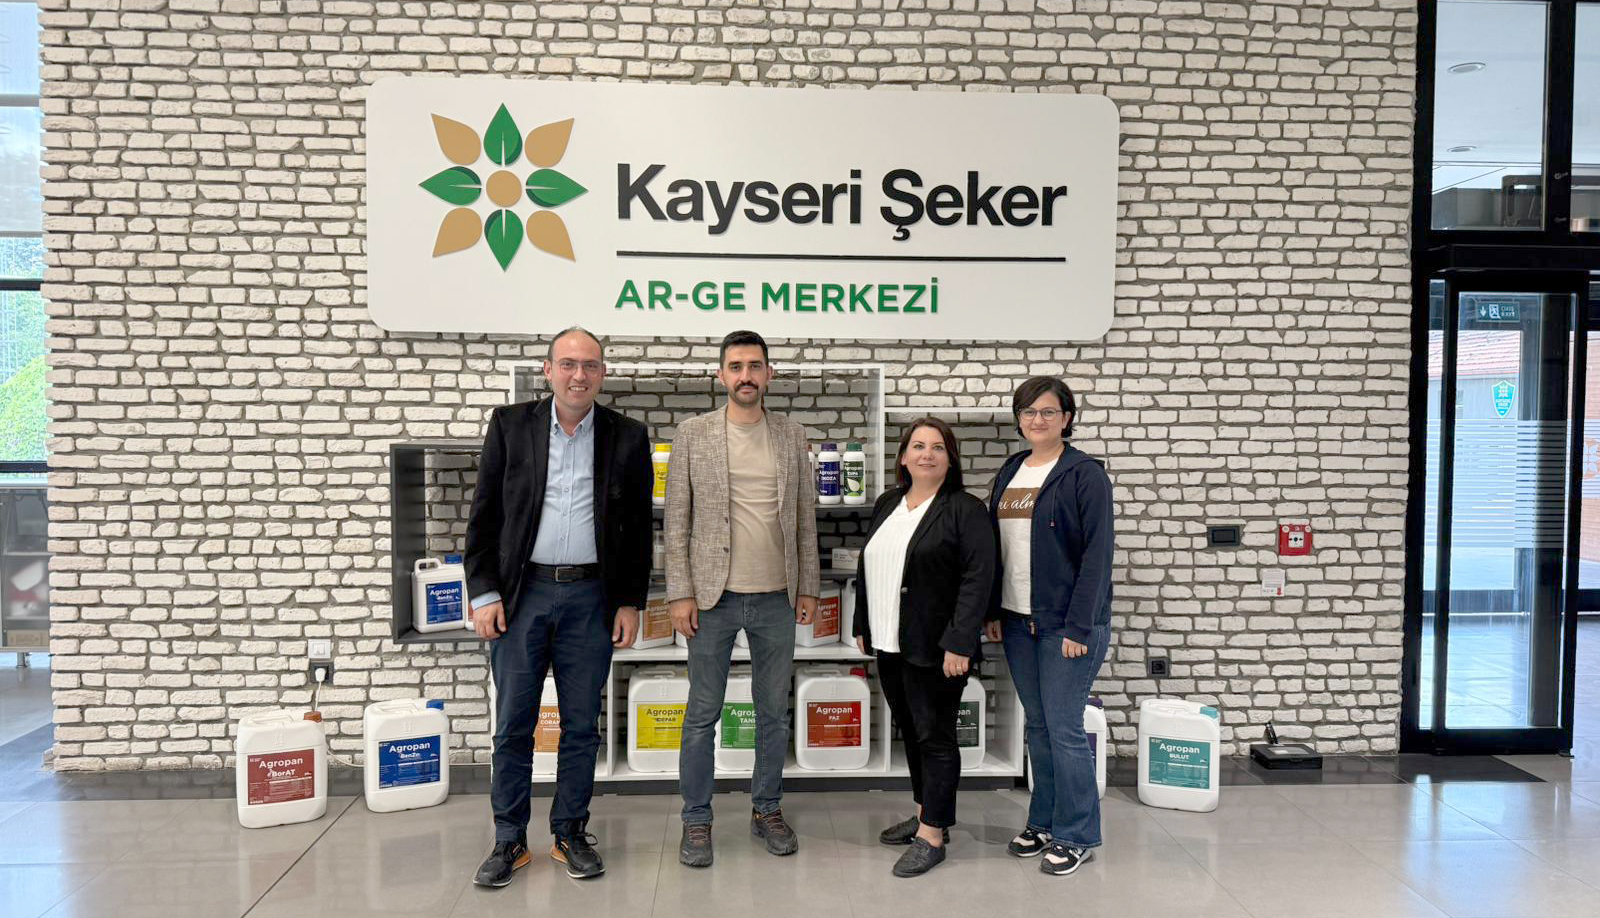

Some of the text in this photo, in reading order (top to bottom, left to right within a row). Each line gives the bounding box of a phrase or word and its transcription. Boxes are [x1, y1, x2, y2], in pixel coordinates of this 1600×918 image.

[616, 162, 1068, 242] Kayseri Şeker
[615, 277, 939, 314] AR-GE MERKEZİ
[1011, 493, 1035, 510] alm
[429, 587, 459, 597] Agropan
[646, 708, 684, 717] Agropan
[815, 706, 853, 716] Agropan
[389, 742, 431, 754] Agropan
[1159, 743, 1200, 754] Agropan
[259, 757, 304, 769] Agropan
